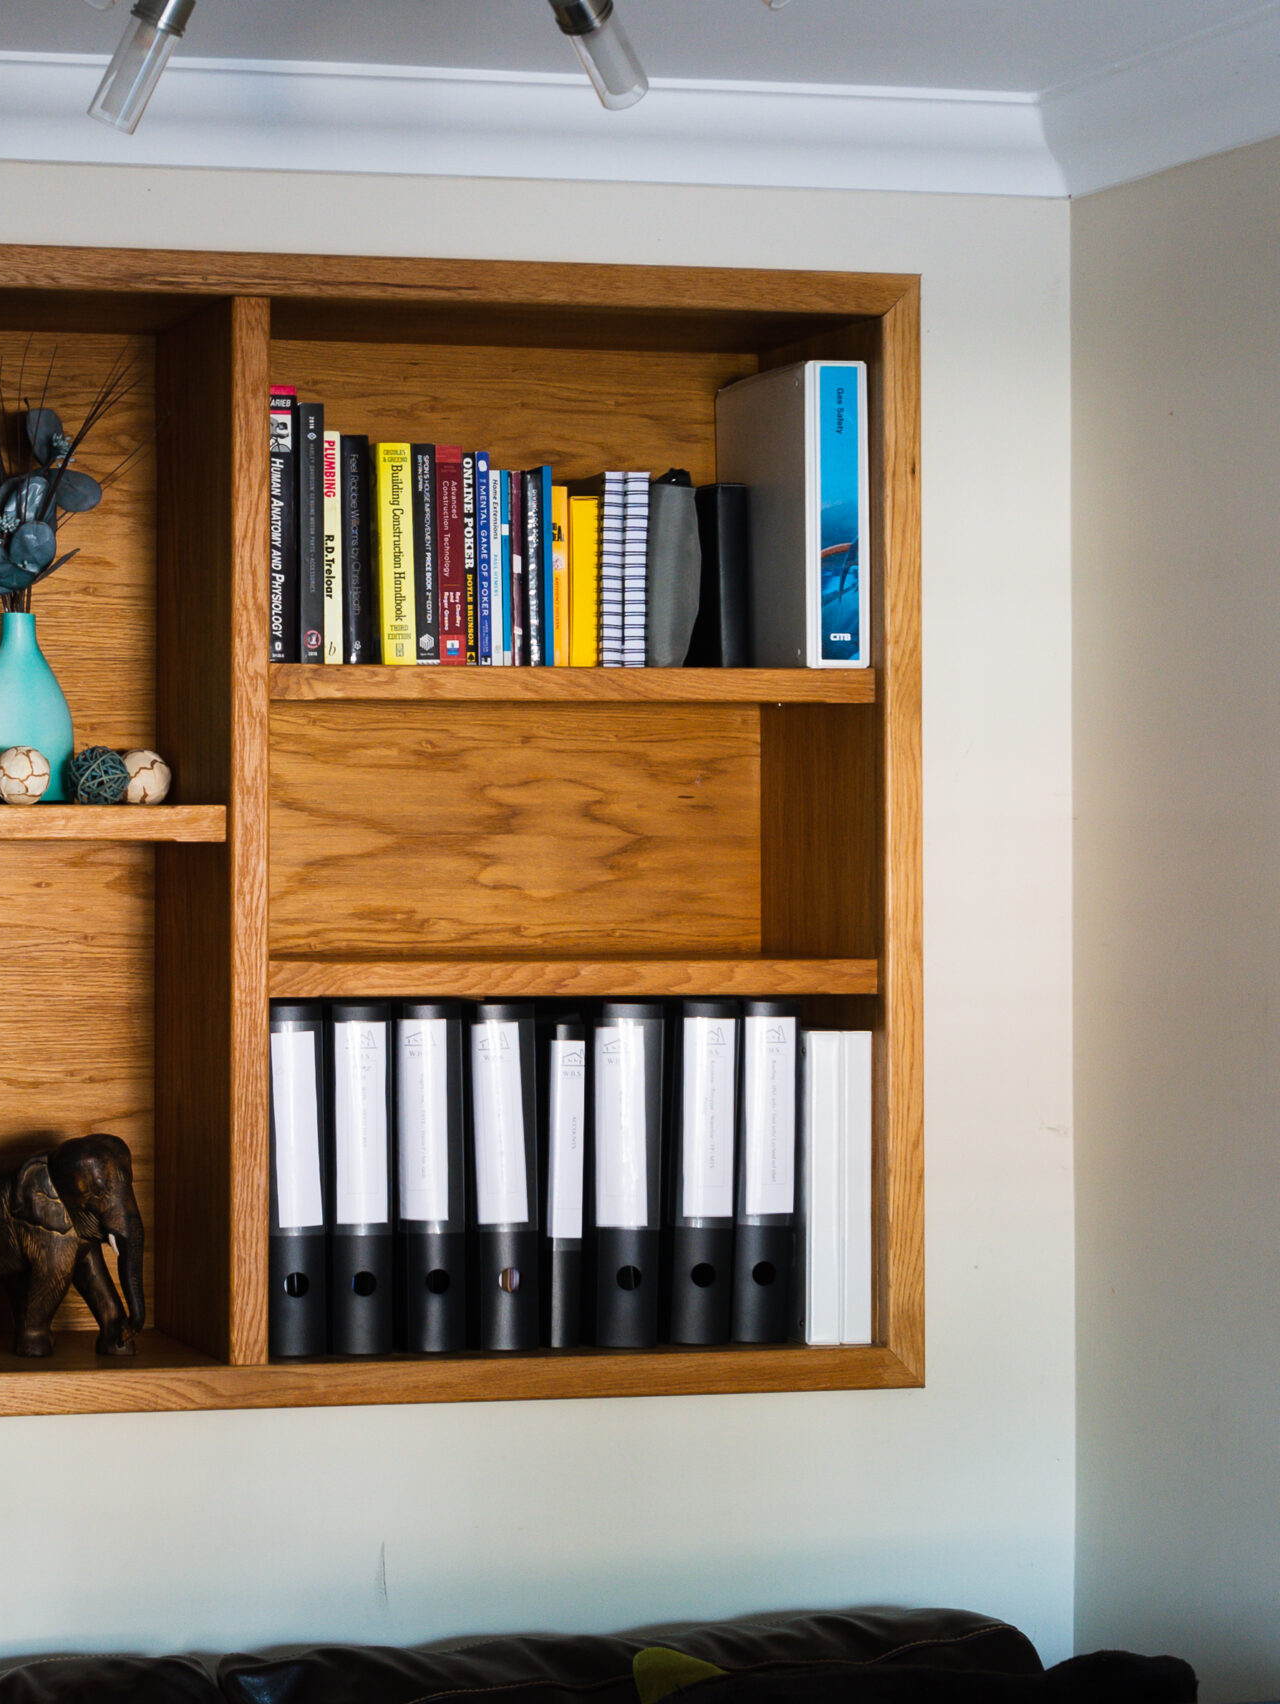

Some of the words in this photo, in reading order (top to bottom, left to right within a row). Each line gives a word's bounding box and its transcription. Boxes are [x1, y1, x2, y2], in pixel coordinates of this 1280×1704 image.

[270, 399, 291, 407] ARIEB
[837, 387, 845, 405] Gas
[835, 407, 845, 434] Safety
[271, 458, 284, 496] HUMAN
[324, 440, 336, 498] PLUMBING
[389, 464, 404, 506] Building
[463, 457, 474, 514] ONLINE
[350, 474, 360, 509] Robbie
[442, 480, 450, 531] Construction
[480, 485, 488, 526] MENTAL
[271, 498, 284, 547] ANATOMY
[392, 508, 405, 569] Construction
[424, 503, 432, 551] IMPROVEMENT
[464, 517, 475, 569] POKER
[443, 533, 451, 577] Technology
[480, 529, 488, 559] GAME
[324, 534, 336, 599] R.D.Treloar
[481, 564, 489, 577] OF
[271, 573, 285, 637] PHYSIOLOGY
[393, 571, 407, 622] Handbook
[466, 574, 474, 602] DOYLE
[481, 582, 489, 616] POKER
[467, 604, 475, 646] BRUNSON
